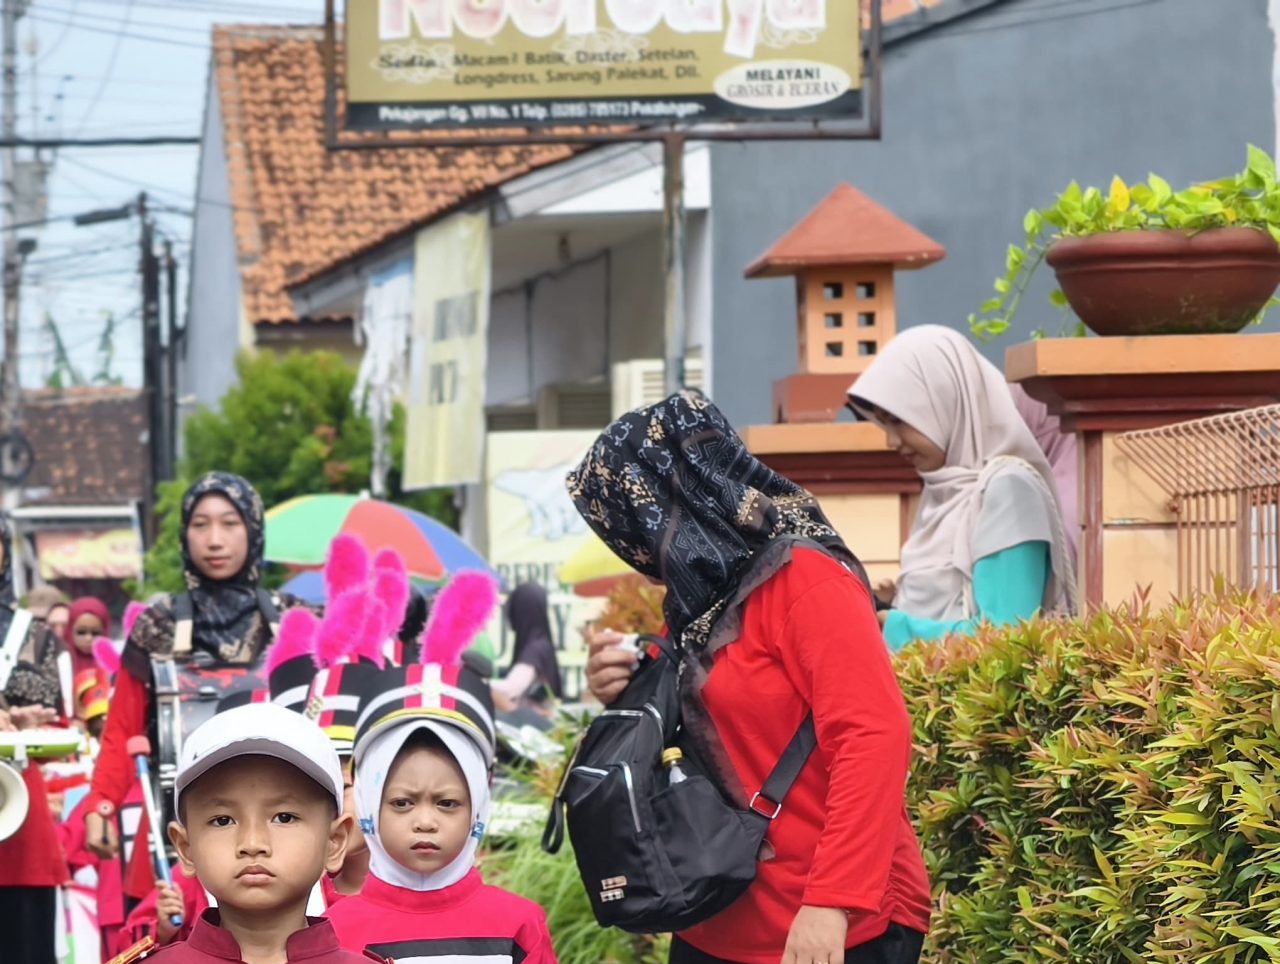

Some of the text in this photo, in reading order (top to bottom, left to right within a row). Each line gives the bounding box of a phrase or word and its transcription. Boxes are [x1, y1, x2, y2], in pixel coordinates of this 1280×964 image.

[546, 69, 601, 85] Sarung
[745, 67, 821, 82] MELAYANI
[726, 83, 773, 99] GROSIR
[789, 81, 839, 97] ECERAN
